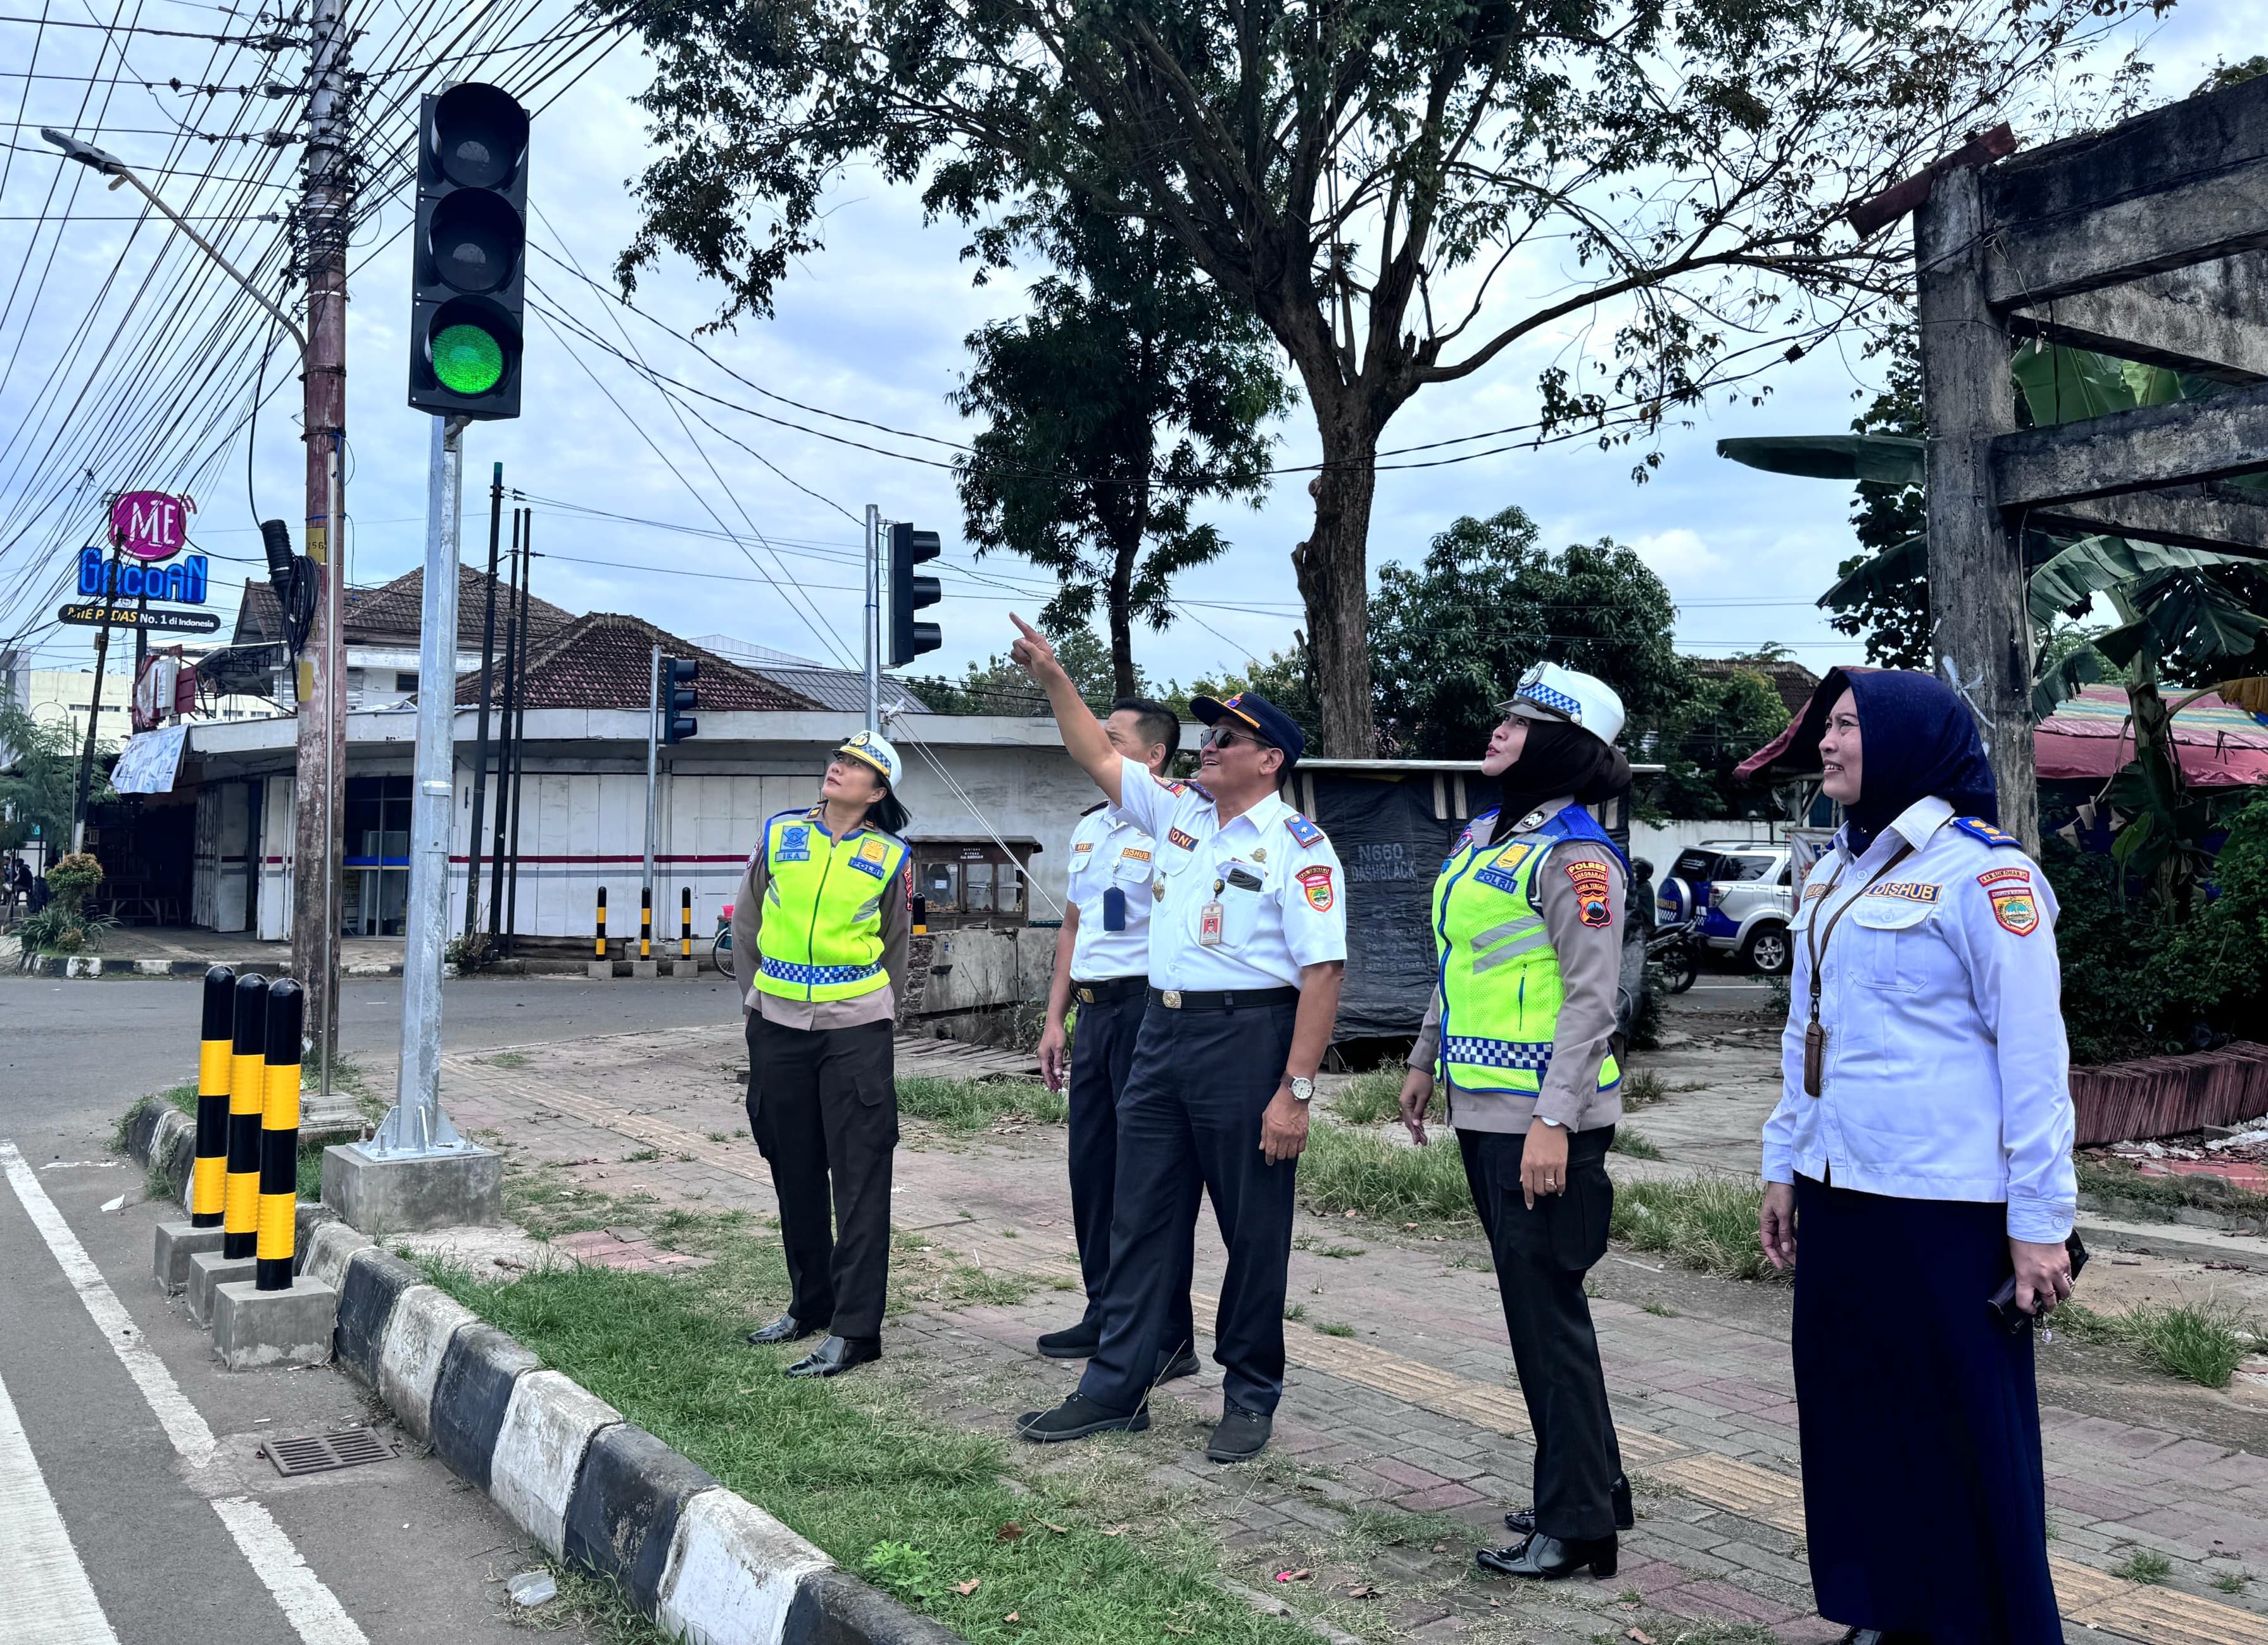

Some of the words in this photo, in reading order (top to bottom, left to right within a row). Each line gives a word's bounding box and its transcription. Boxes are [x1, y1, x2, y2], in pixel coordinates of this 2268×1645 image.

[95, 608, 138, 622] PDAS
[140, 614, 158, 624] No.
[160, 614, 167, 624] 1
[169, 617, 177, 626] di
[179, 617, 214, 628] Indonesia
[1124, 848, 1149, 860] DISHUB
[1358, 843, 1403, 861] N660
[1568, 862, 1606, 873] POLRES
[1874, 883, 1935, 900] DISHUB
